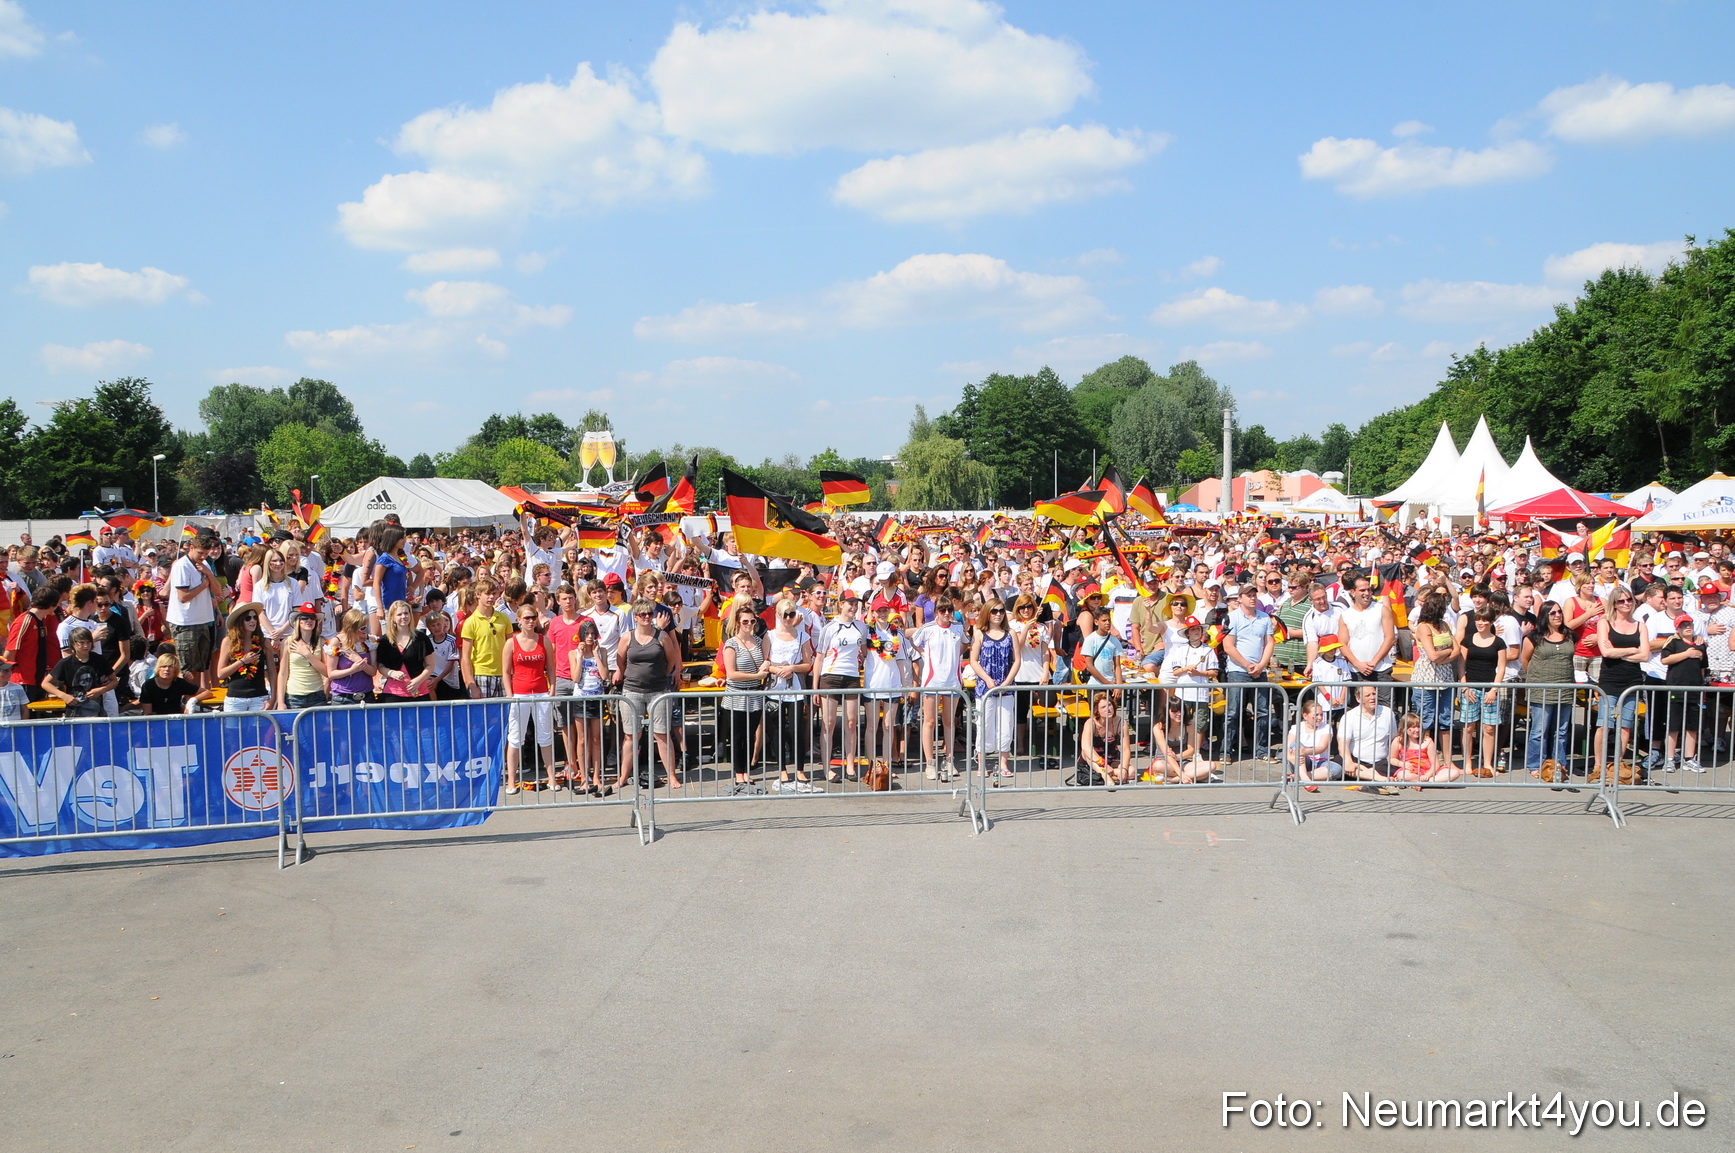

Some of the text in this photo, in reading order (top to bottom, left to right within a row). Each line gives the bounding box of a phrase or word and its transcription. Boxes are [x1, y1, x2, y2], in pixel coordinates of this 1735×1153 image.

[367, 502, 397, 510] adidas
[633, 512, 676, 526] DEUTSCHLAND
[839, 638, 848, 646] 16
